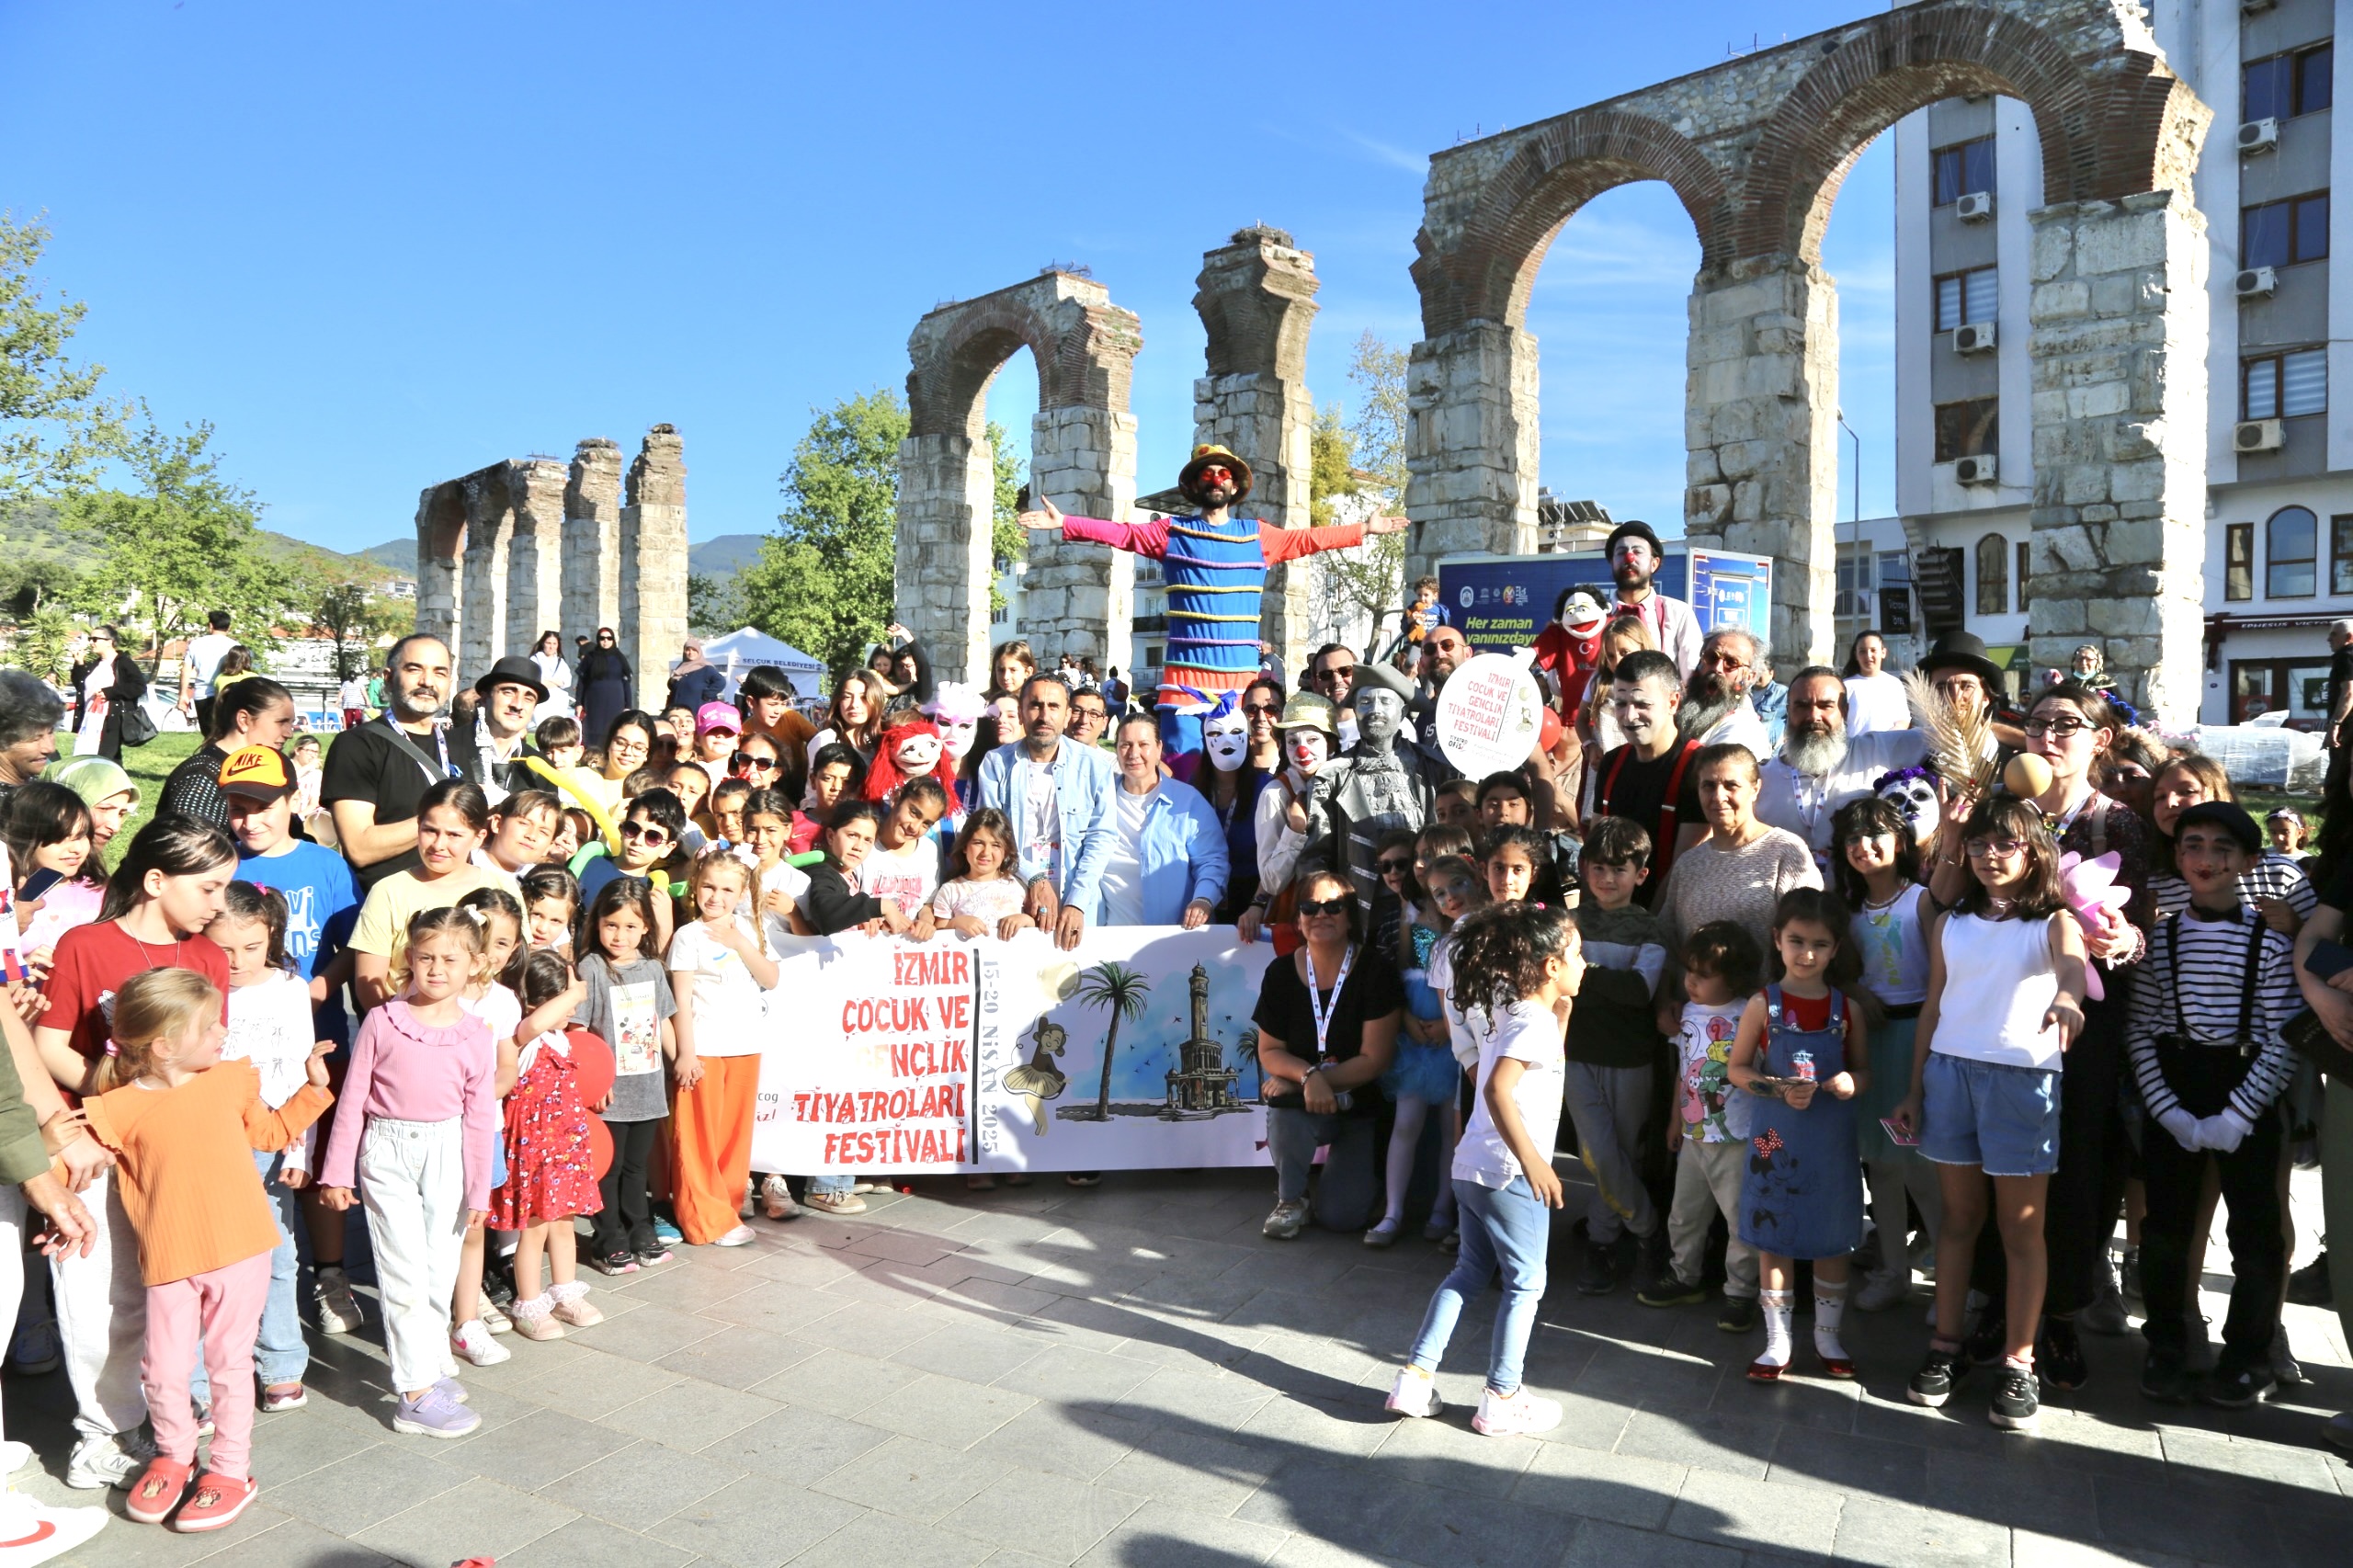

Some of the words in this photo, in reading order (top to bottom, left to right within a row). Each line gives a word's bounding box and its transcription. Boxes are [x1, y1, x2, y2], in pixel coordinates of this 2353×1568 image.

[1465, 617, 1488, 630] Her
[1490, 619, 1533, 630] zaman
[773, 660, 815, 670] BELEDİYESİ
[1497, 689, 1508, 701] VE
[233, 753, 264, 767] NIKE
[893, 943, 969, 985] İZMİR
[983, 960, 1000, 1014] 15-20
[842, 996, 929, 1041] ÇOCUK
[937, 994, 970, 1029] VE
[793, 1083, 965, 1123] TİYATROLARI
[824, 1119, 965, 1165] FESTİVALİ
[982, 1104, 999, 1153] 2025
